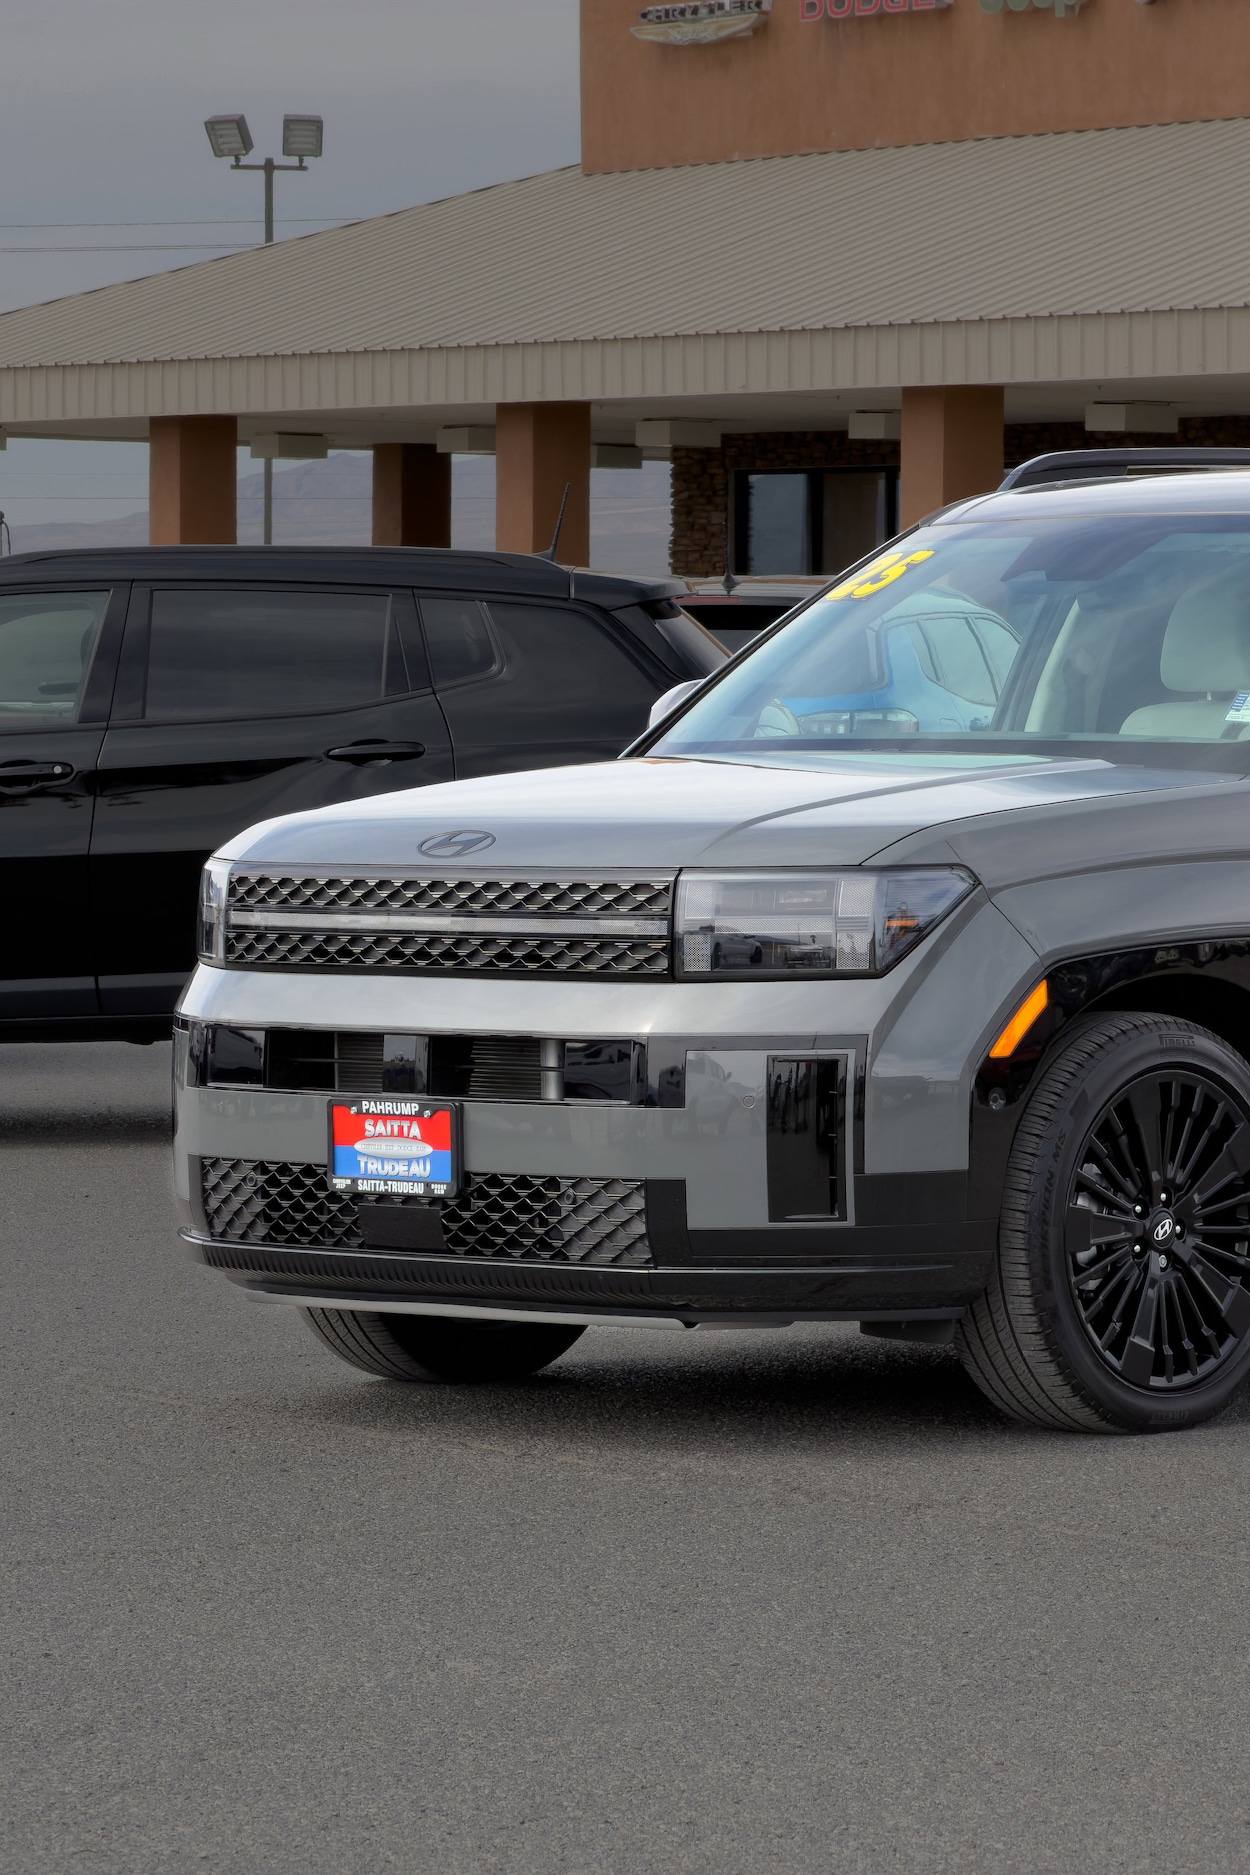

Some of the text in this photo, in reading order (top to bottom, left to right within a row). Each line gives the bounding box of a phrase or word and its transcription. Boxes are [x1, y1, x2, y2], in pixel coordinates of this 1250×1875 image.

[826, 550, 936, 600] 25
[1158, 1033, 1196, 1048] PIRELLI
[361, 1100, 420, 1116] PAHRUMP
[364, 1118, 422, 1140] SAITTA
[357, 1155, 431, 1178] TRUDEAU
[357, 1179, 424, 1194] SAITTA-TRUDEAU
